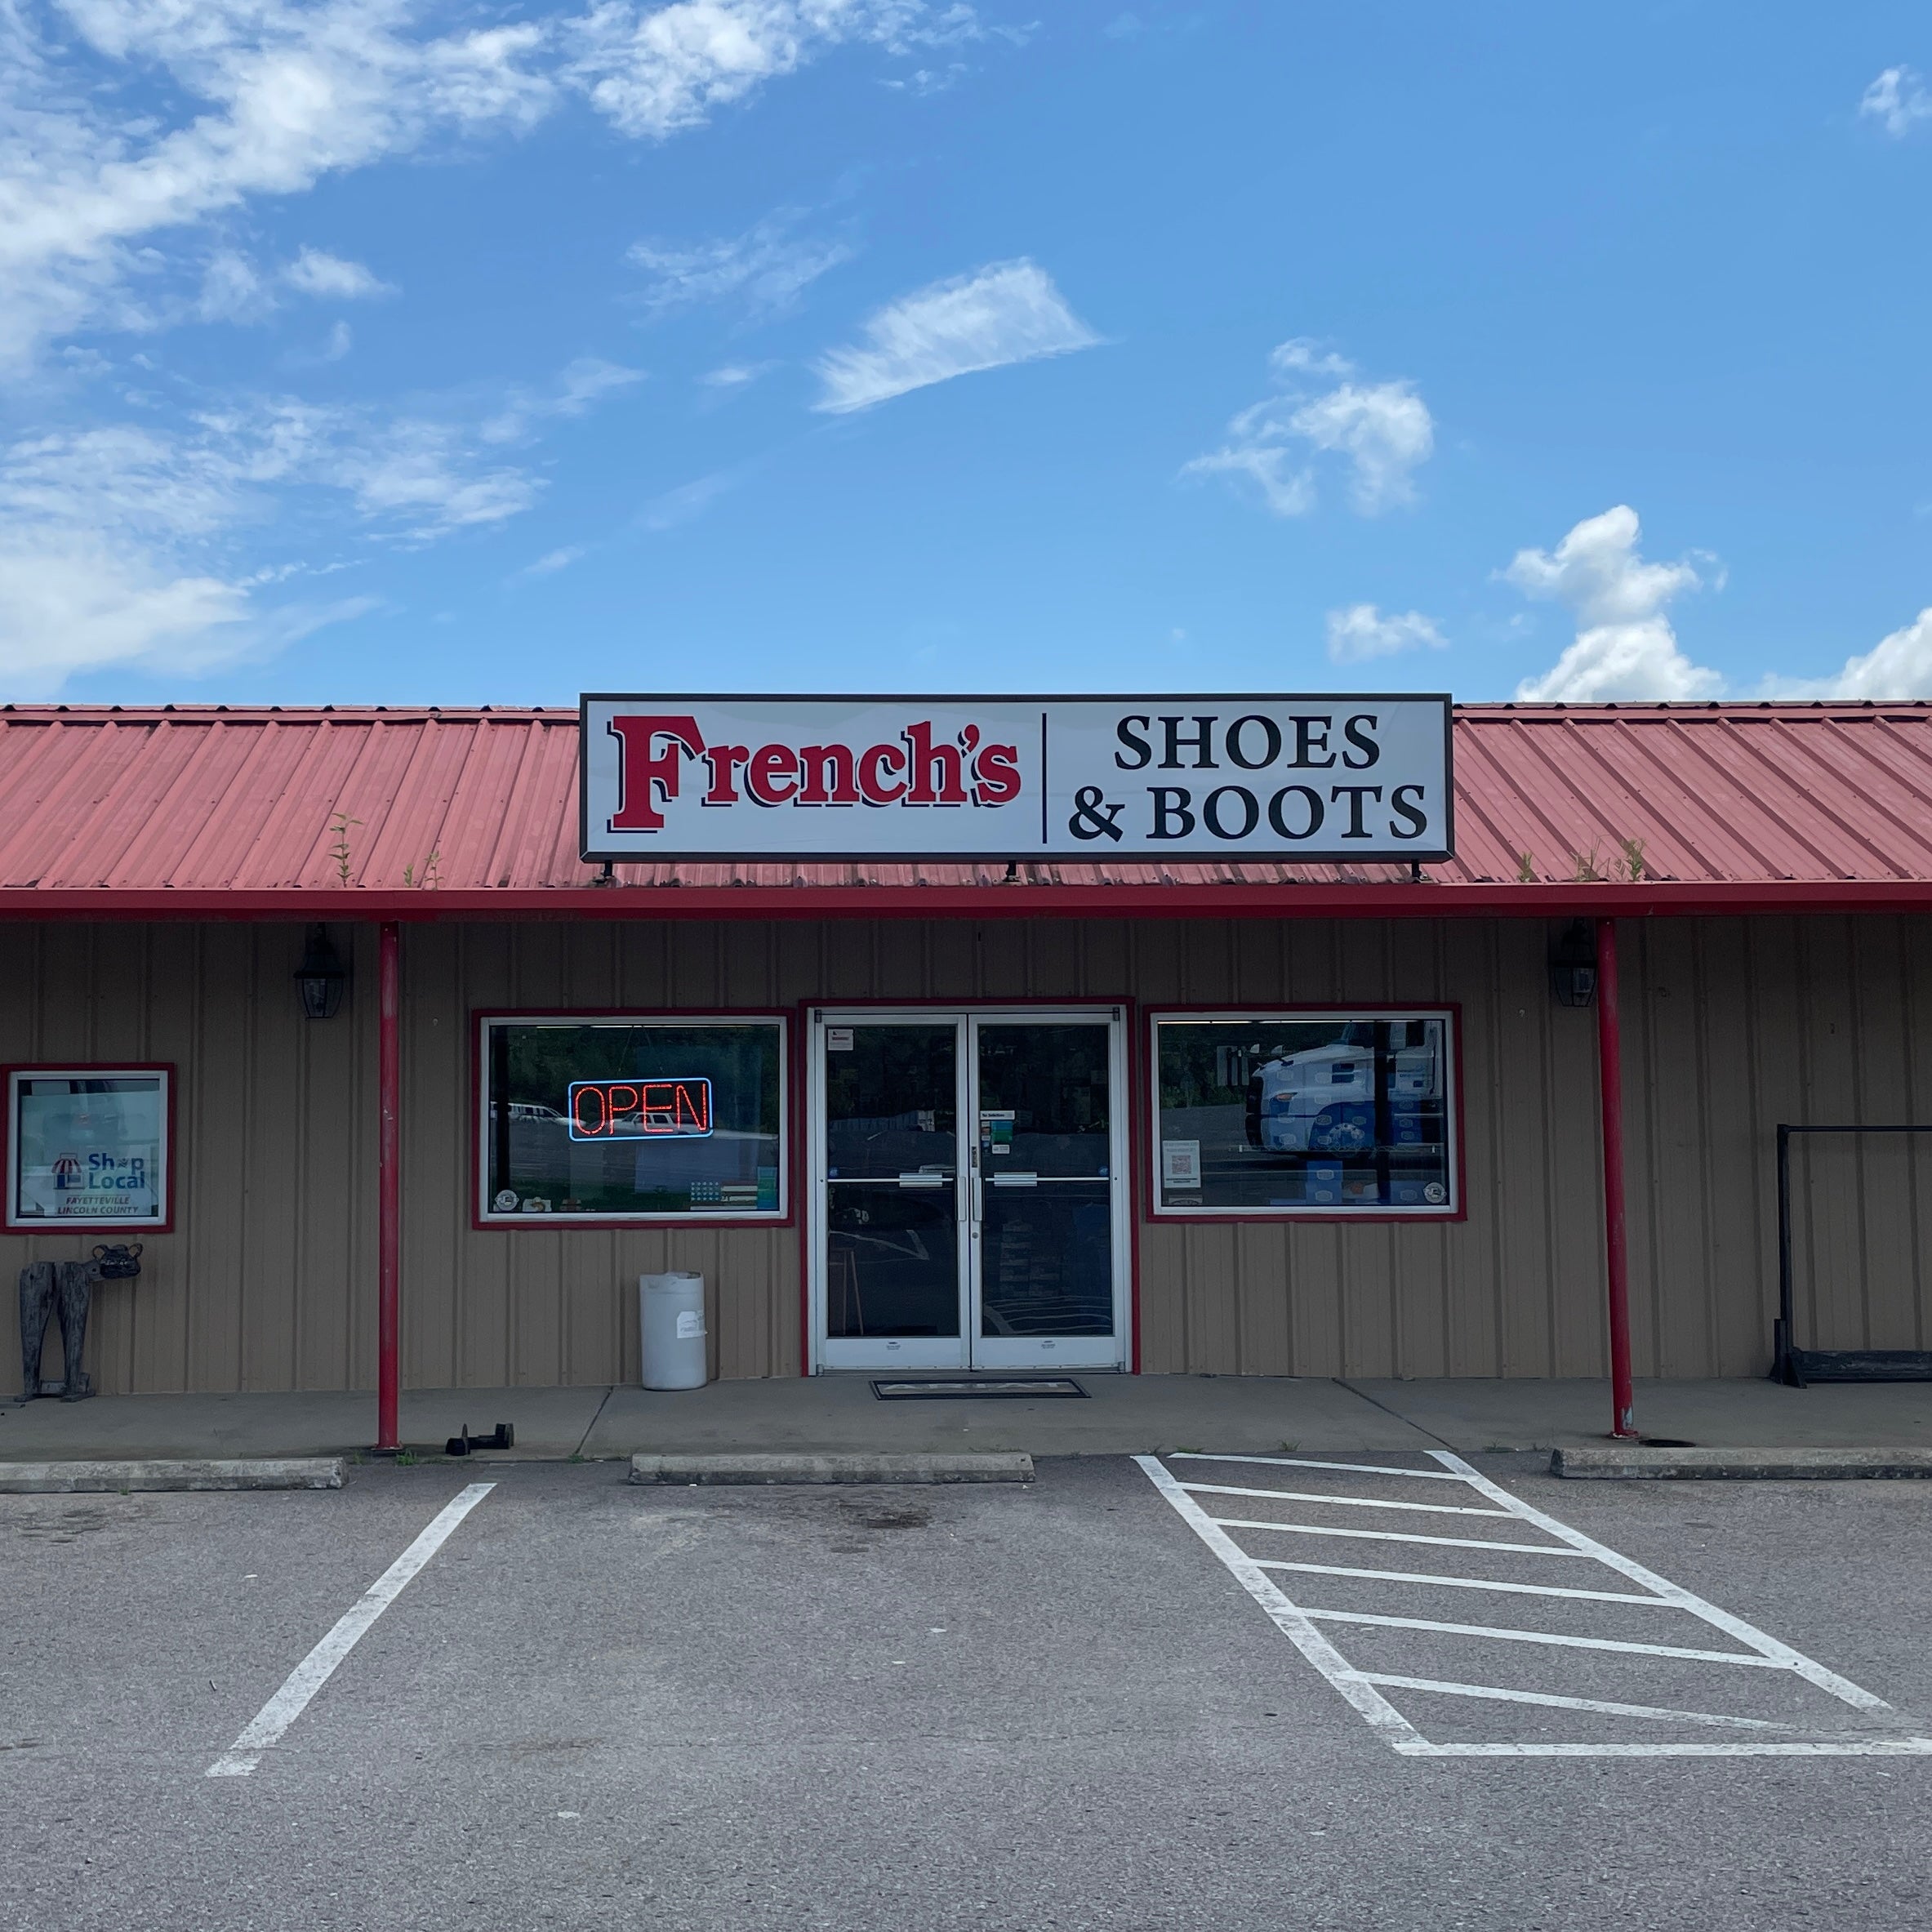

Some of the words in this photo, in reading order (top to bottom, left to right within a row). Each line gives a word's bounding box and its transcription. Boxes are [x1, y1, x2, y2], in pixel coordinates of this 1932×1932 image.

[1115, 714, 1380, 769] SHOES
[607, 716, 1022, 833] French's
[1069, 786, 1125, 842] &
[1146, 785, 1427, 839] BOOTS
[575, 1084, 706, 1134] OPEN
[88, 1153, 144, 1174] Shp
[89, 1172, 145, 1189] Local
[57, 1206, 98, 1214] LINCOLN
[100, 1206, 139, 1214] COUNTY
[66, 1196, 130, 1204] FAYETTEVILLE
